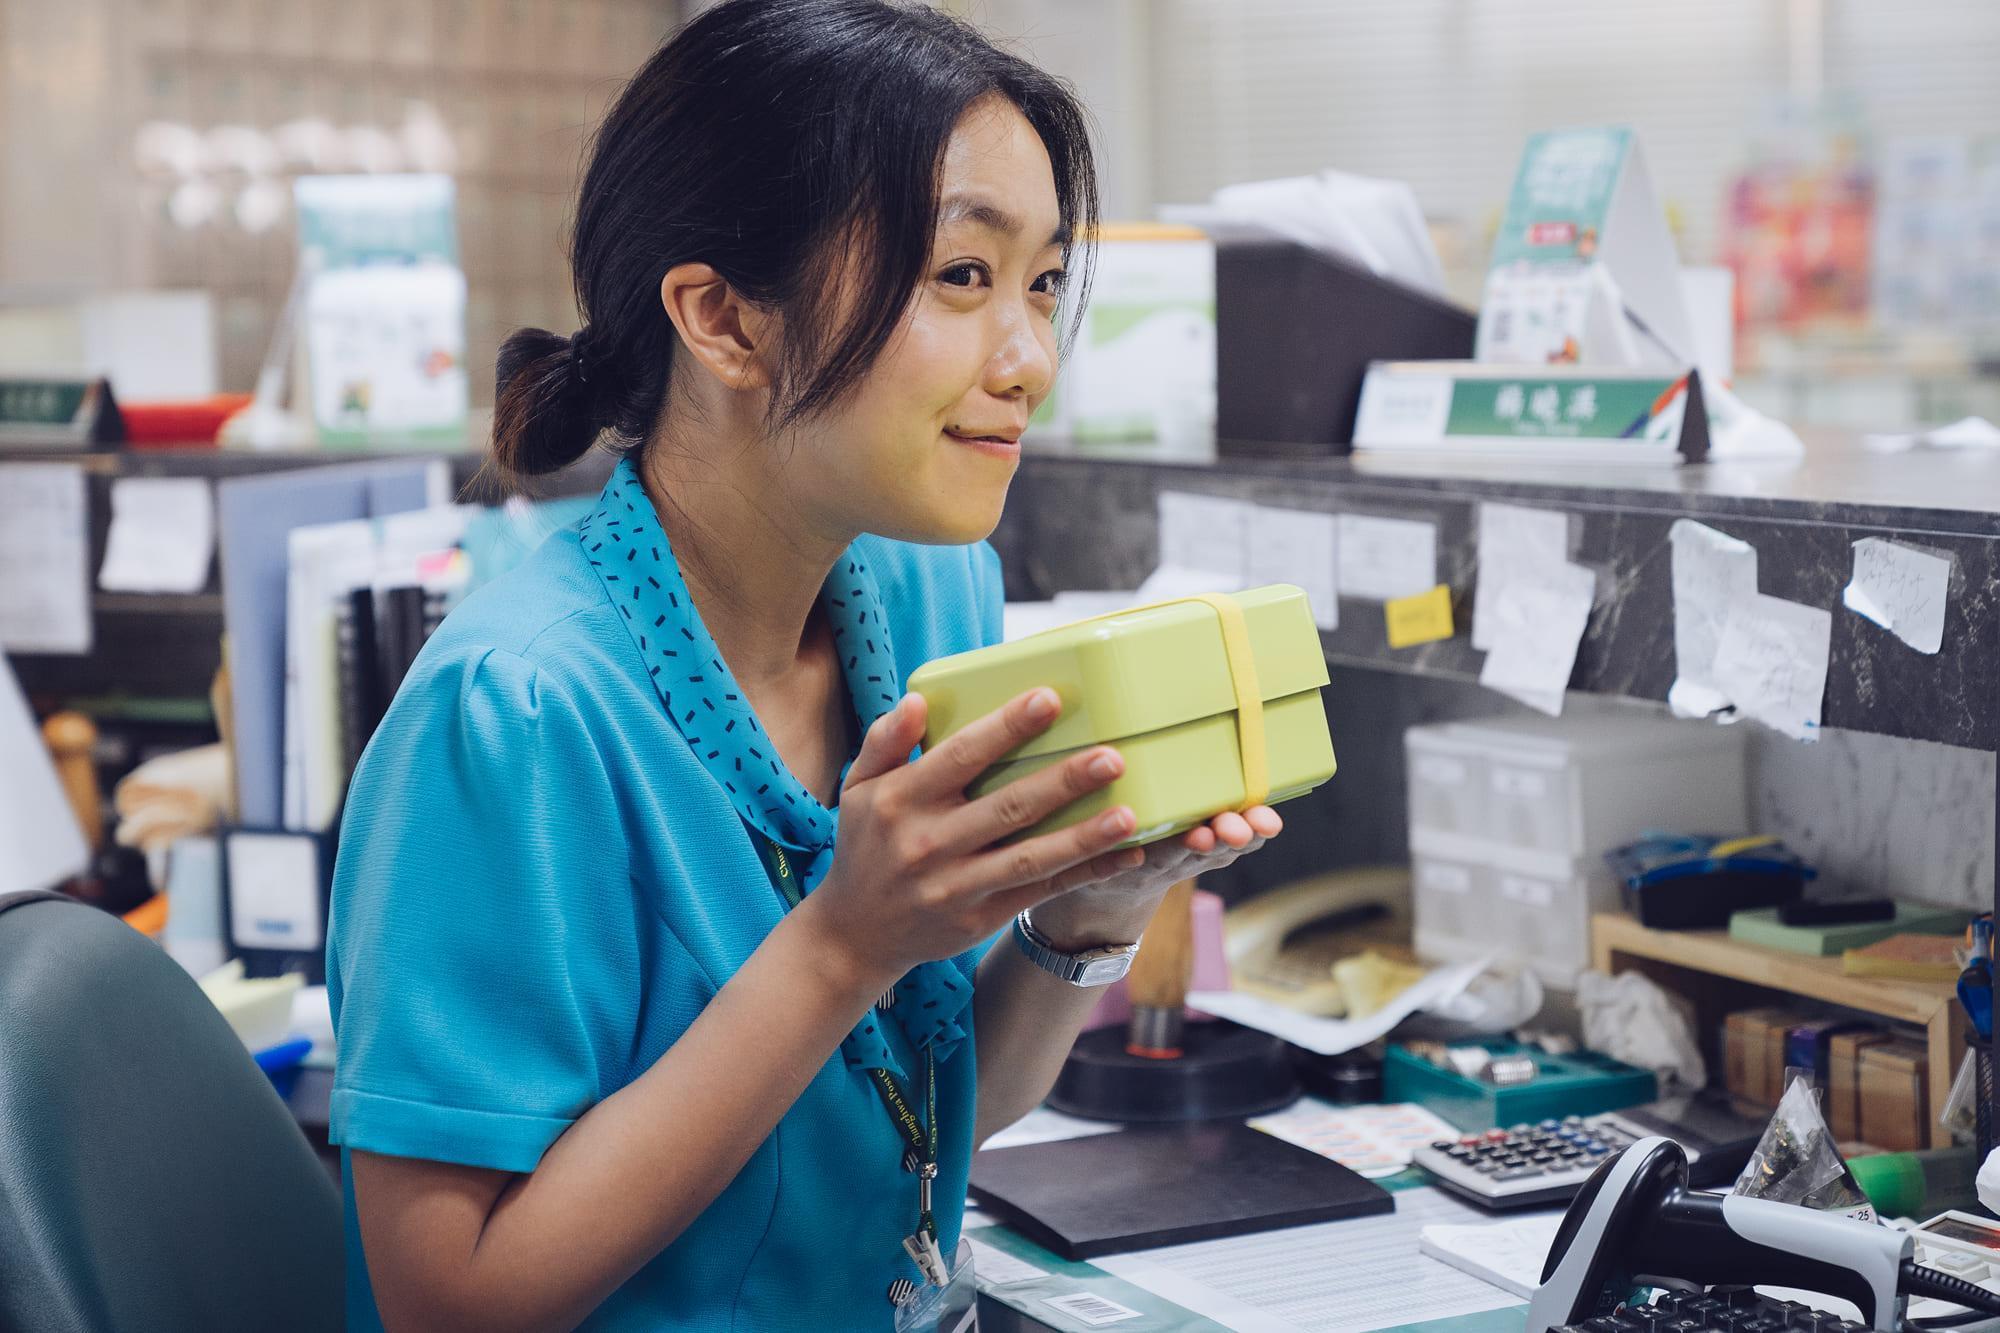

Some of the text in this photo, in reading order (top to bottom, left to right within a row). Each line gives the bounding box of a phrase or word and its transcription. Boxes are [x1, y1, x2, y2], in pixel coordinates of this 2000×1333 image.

[883, 1076, 899, 1101] Post
[895, 1098, 922, 1147] Chunghwa
[1857, 1210, 1870, 1221] 25
